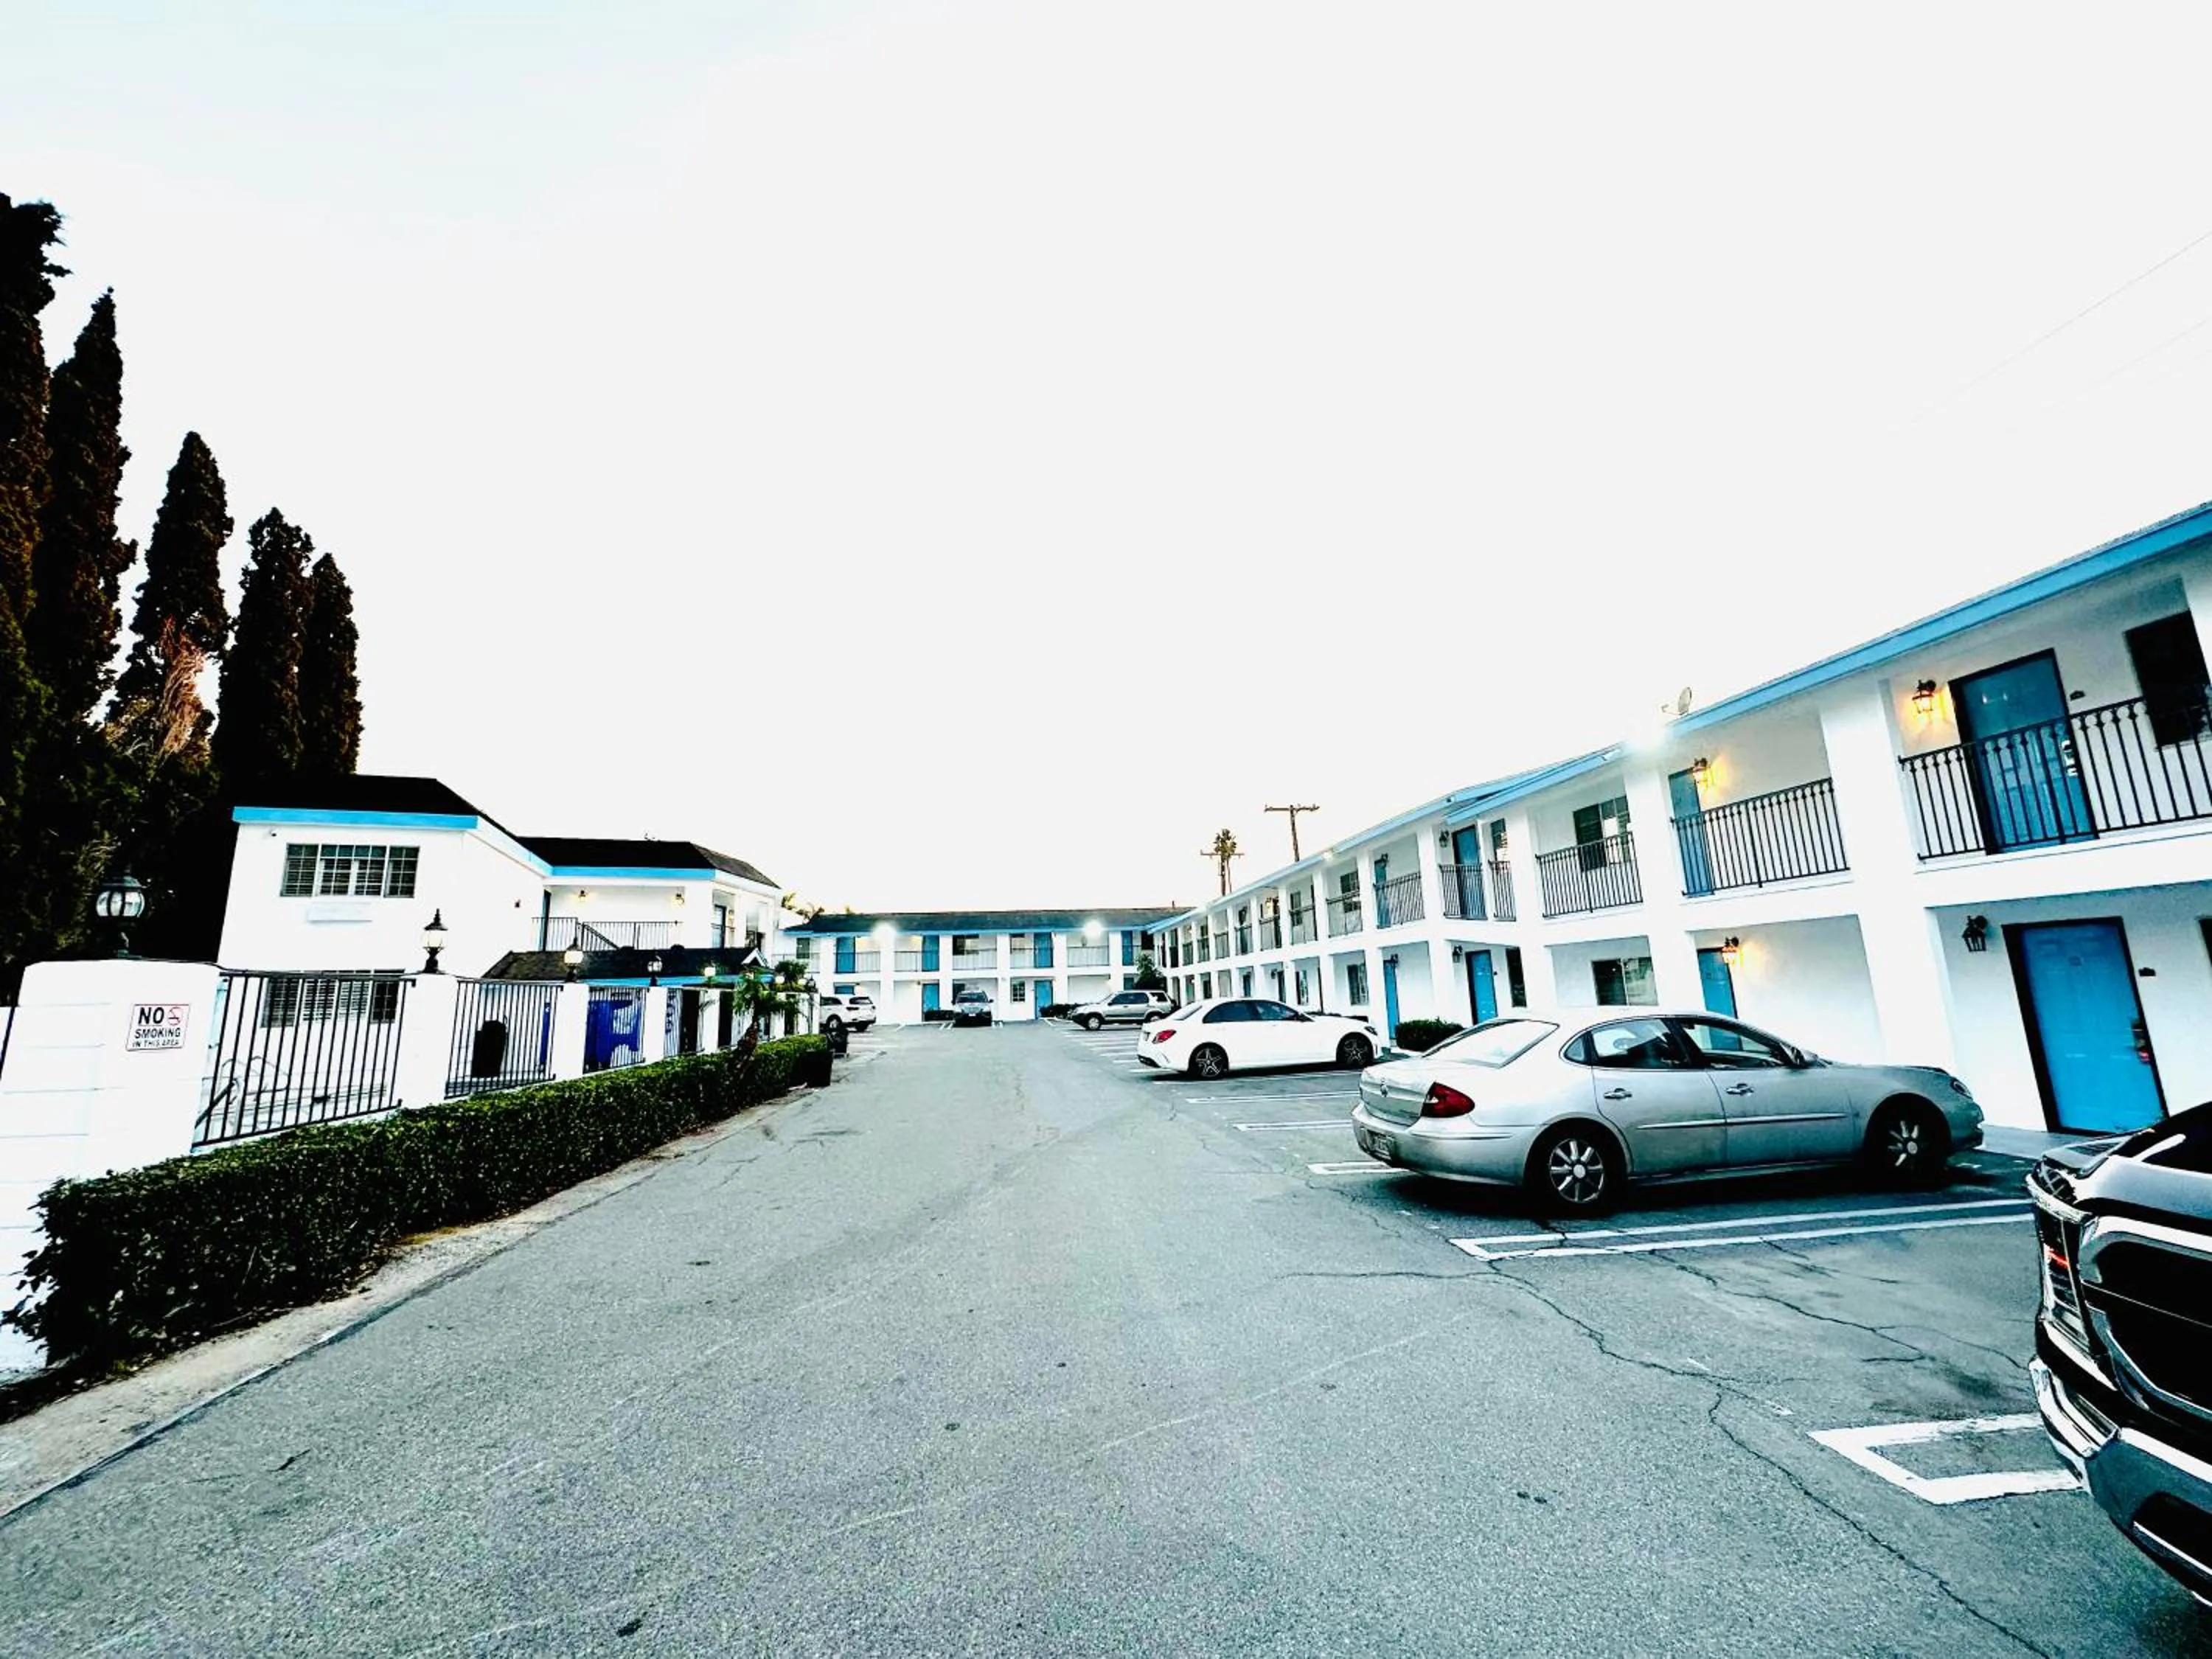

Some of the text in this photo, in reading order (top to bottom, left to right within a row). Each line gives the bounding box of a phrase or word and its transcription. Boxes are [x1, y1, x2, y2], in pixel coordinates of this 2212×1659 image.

[138, 1006, 164, 1024] NO
[135, 1027, 181, 1039] SMOKING
[144, 1039, 160, 1047] THIS
